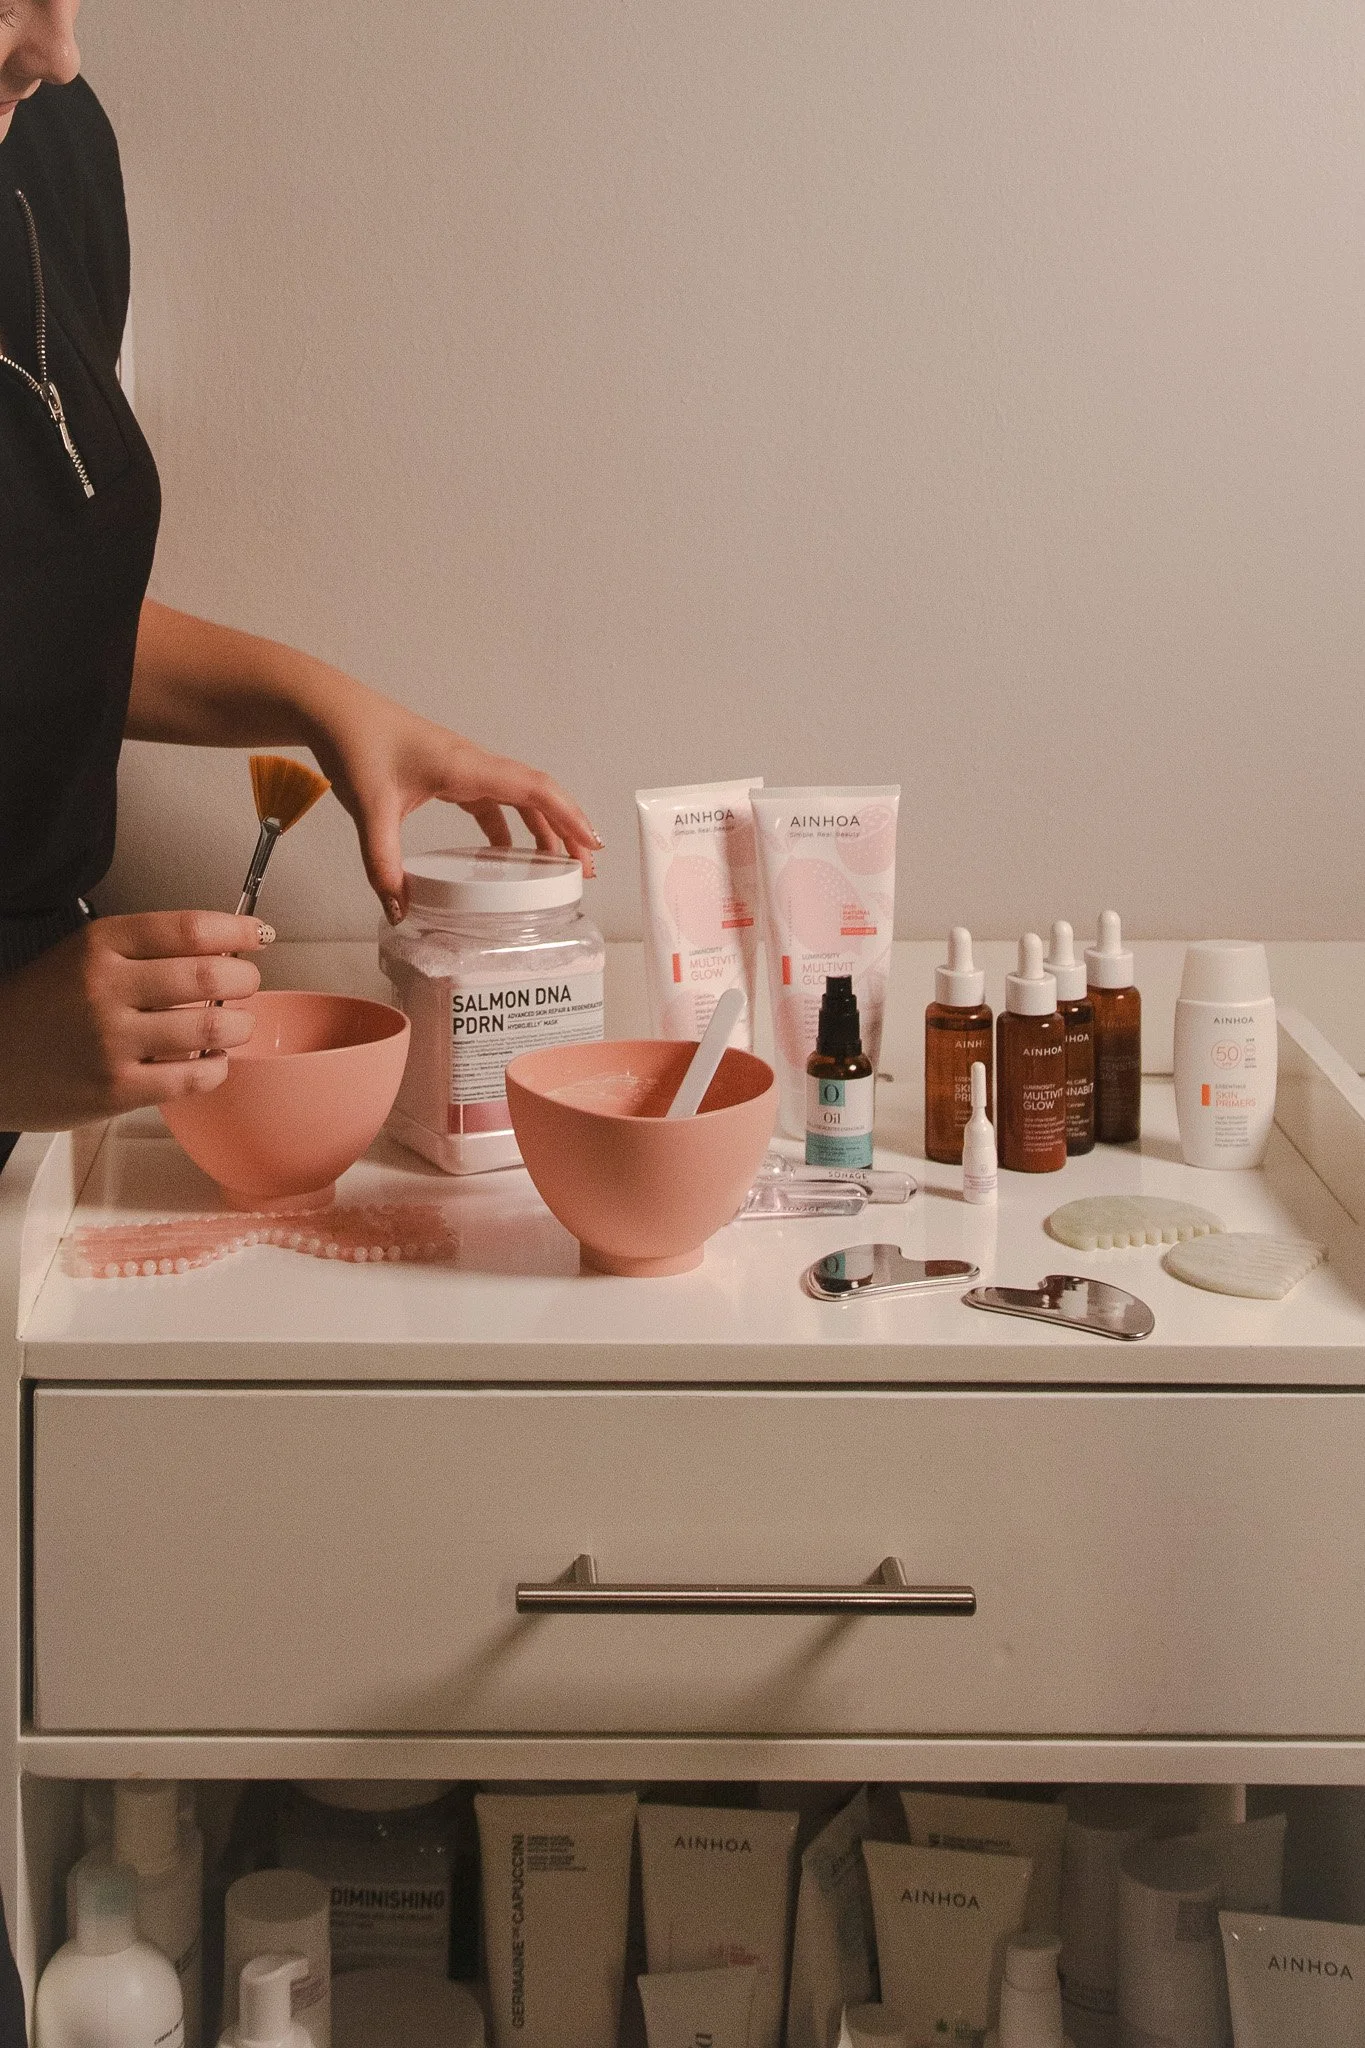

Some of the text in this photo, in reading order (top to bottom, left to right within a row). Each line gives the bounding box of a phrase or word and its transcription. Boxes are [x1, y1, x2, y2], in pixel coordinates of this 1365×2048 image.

[674, 809, 735, 826] AINHOA
[790, 815, 860, 827] AINHOA
[690, 954, 738, 969] MULTIVIT
[801, 953, 841, 961] LUMINOSITY
[690, 968, 725, 982] GLOW
[802, 962, 856, 974] MULTIVIT
[802, 974, 827, 986] GLO
[452, 984, 572, 1013] SALMON DNA
[507, 1010, 535, 1019] ADVANCED
[535, 1009, 548, 1017] SKIN
[548, 1007, 566, 1015] REPAIR
[453, 1014, 504, 1036] PDRN
[543, 1018, 558, 1026] MASK
[1213, 1016, 1255, 1025] AINHOA
[1022, 1045, 1063, 1056] AINHOA
[1216, 1046, 1239, 1062] 50
[824, 1083, 840, 1103] O
[1023, 1087, 1064, 1101] MULTIVIT
[1215, 1090, 1238, 1099] SKIN
[1023, 1100, 1055, 1111] GLOW
[1215, 1099, 1256, 1107] PRIMERS
[823, 1112, 841, 1124] Oil
[828, 1171, 867, 1180] SONAGE
[673, 1835, 752, 1854] AINHOA
[511, 1833, 525, 1925] CAPUCCINI
[330, 1886, 445, 1909] DIMINISHING
[900, 1888, 981, 1910] AINHOA
[1267, 1955, 1354, 1981] AINHOA
[512, 1940, 525, 2029] GERMAINE
